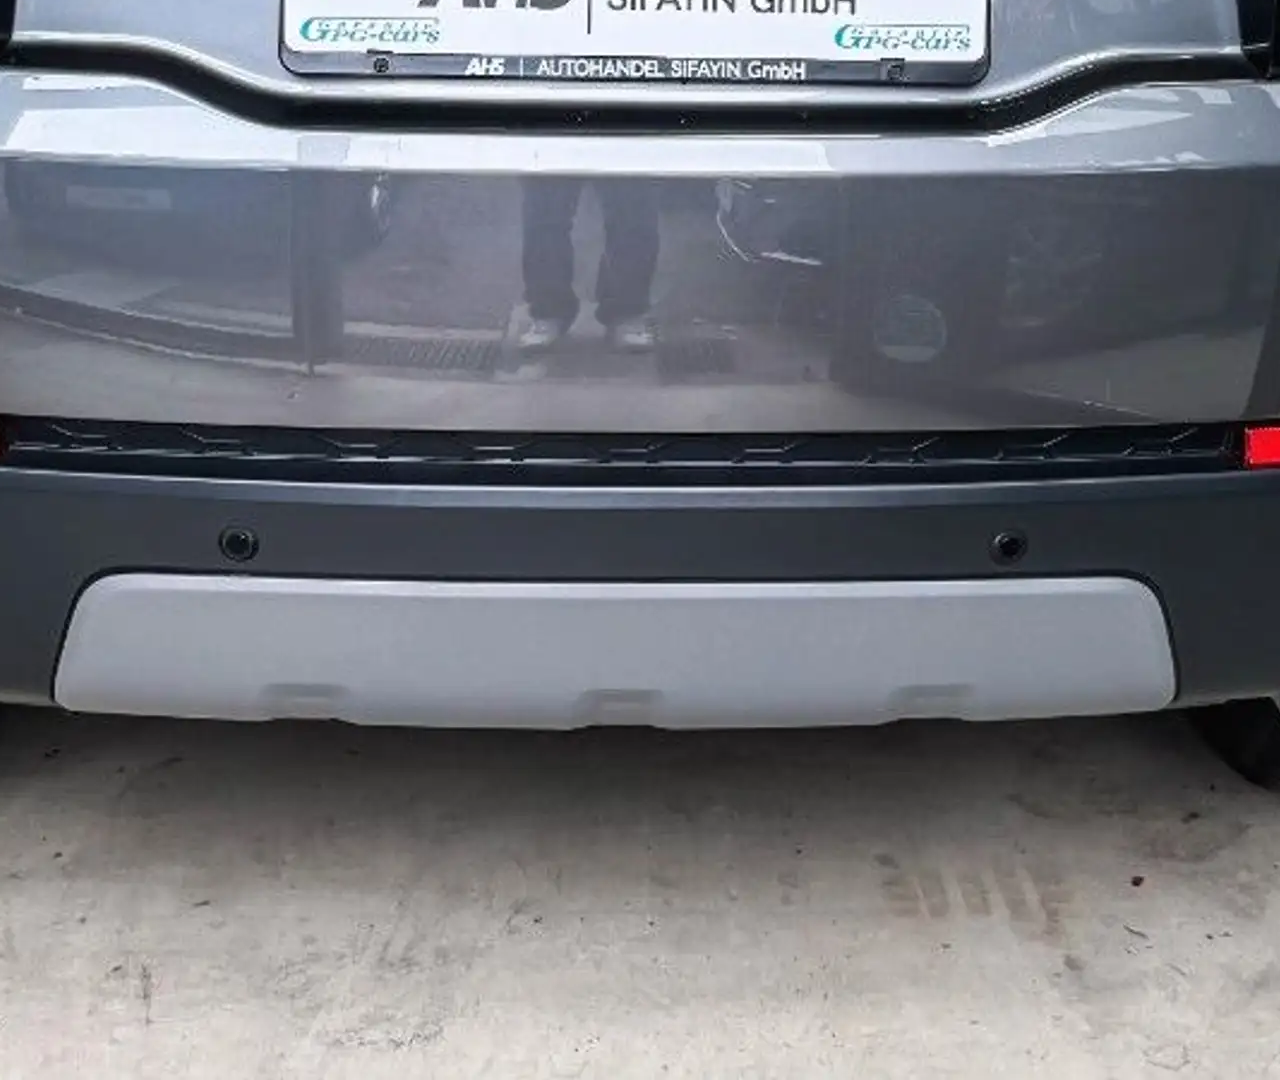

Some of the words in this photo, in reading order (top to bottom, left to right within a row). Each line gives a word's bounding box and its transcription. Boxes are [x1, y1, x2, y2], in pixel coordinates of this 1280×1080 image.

[464, 56, 506, 76] AHS
[535, 57, 666, 78] AUTOHANDEL
[671, 59, 742, 78] SIFAYIN
[748, 60, 807, 81] GmbH
